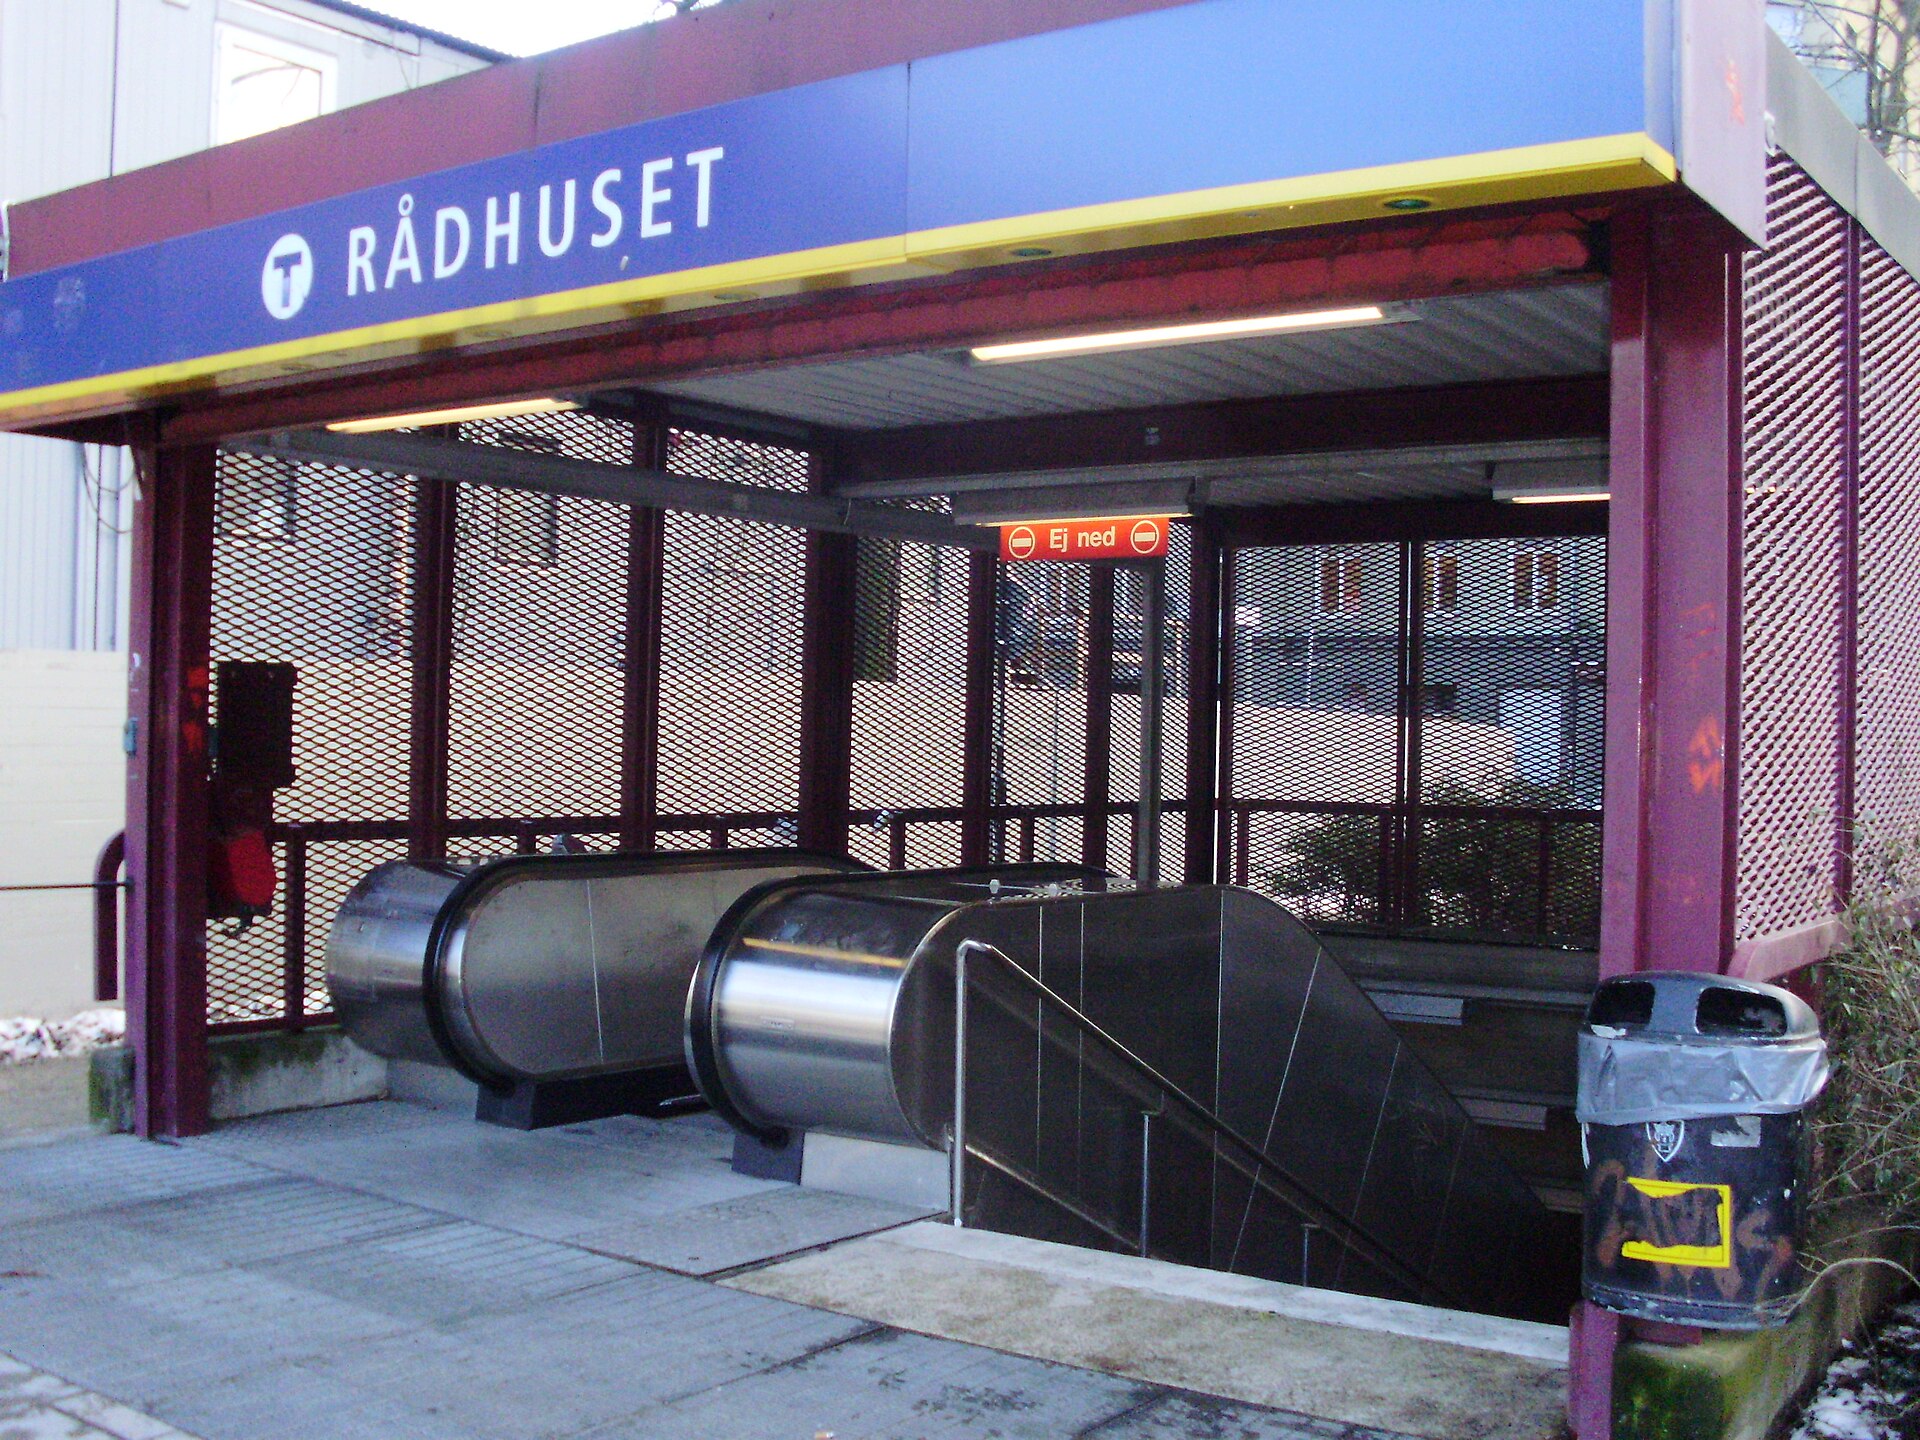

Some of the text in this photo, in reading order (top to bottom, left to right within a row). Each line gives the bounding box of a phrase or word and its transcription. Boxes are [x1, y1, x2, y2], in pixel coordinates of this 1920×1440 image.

[347, 146, 724, 296] RÅDHUSET
[1050, 526, 1116, 552] Ej ned
